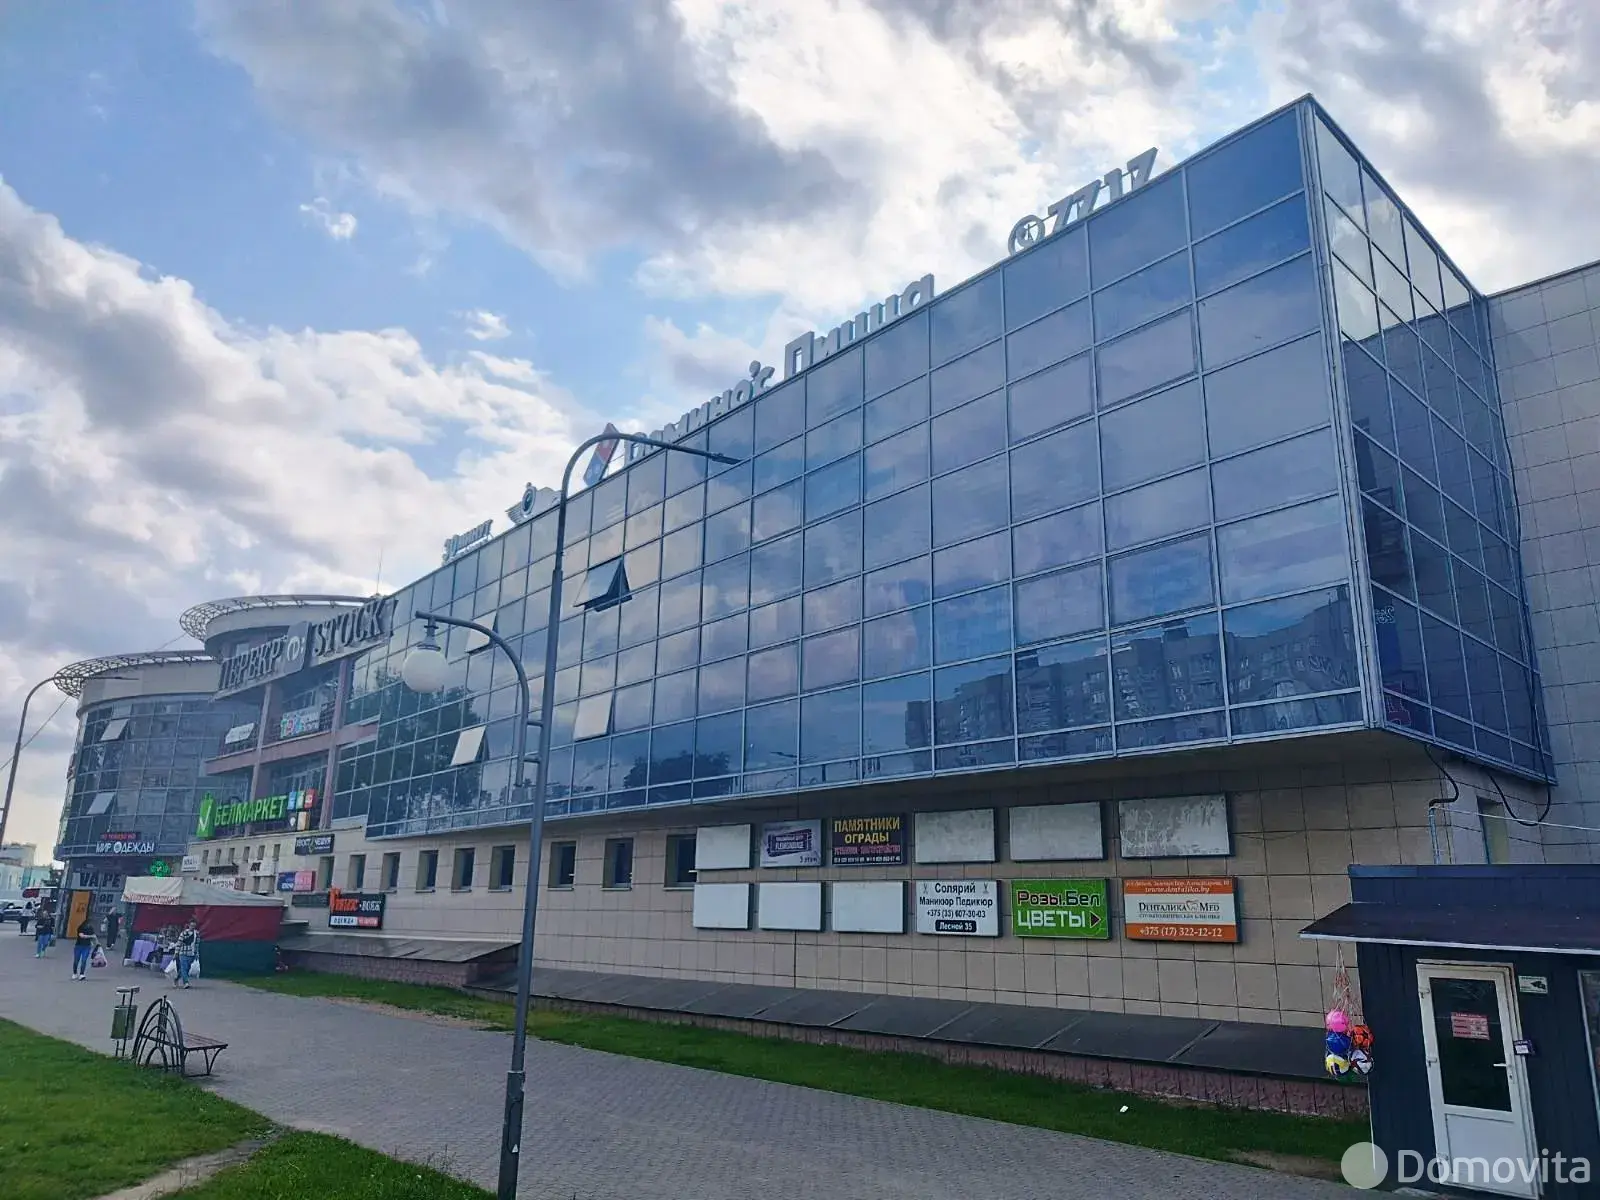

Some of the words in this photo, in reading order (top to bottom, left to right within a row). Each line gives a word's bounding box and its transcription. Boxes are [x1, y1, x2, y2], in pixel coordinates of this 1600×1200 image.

[214, 795, 288, 826] БЕЛМАРКЕТ
[834, 817, 900, 833] ПАМЯТНИКИ
[844, 833, 889, 845] ОГРАДЫ
[95, 842, 112, 853] МИР
[114, 841, 155, 853] ОДЕЖДЫ
[934, 882, 976, 895] Солярий
[920, 897, 954, 907] Маникюр
[956, 897, 993, 908] Педикюр
[1016, 889, 1101, 906] Розы.Бел
[940, 921, 963, 930] Лесной
[965, 922, 973, 930] 35
[1017, 910, 1086, 929] ЦВЕТЫ
[1140, 926, 1159, 936] +375
[1161, 926, 1177, 936] (17)
[1179, 927, 1223, 937] 322-12-12
